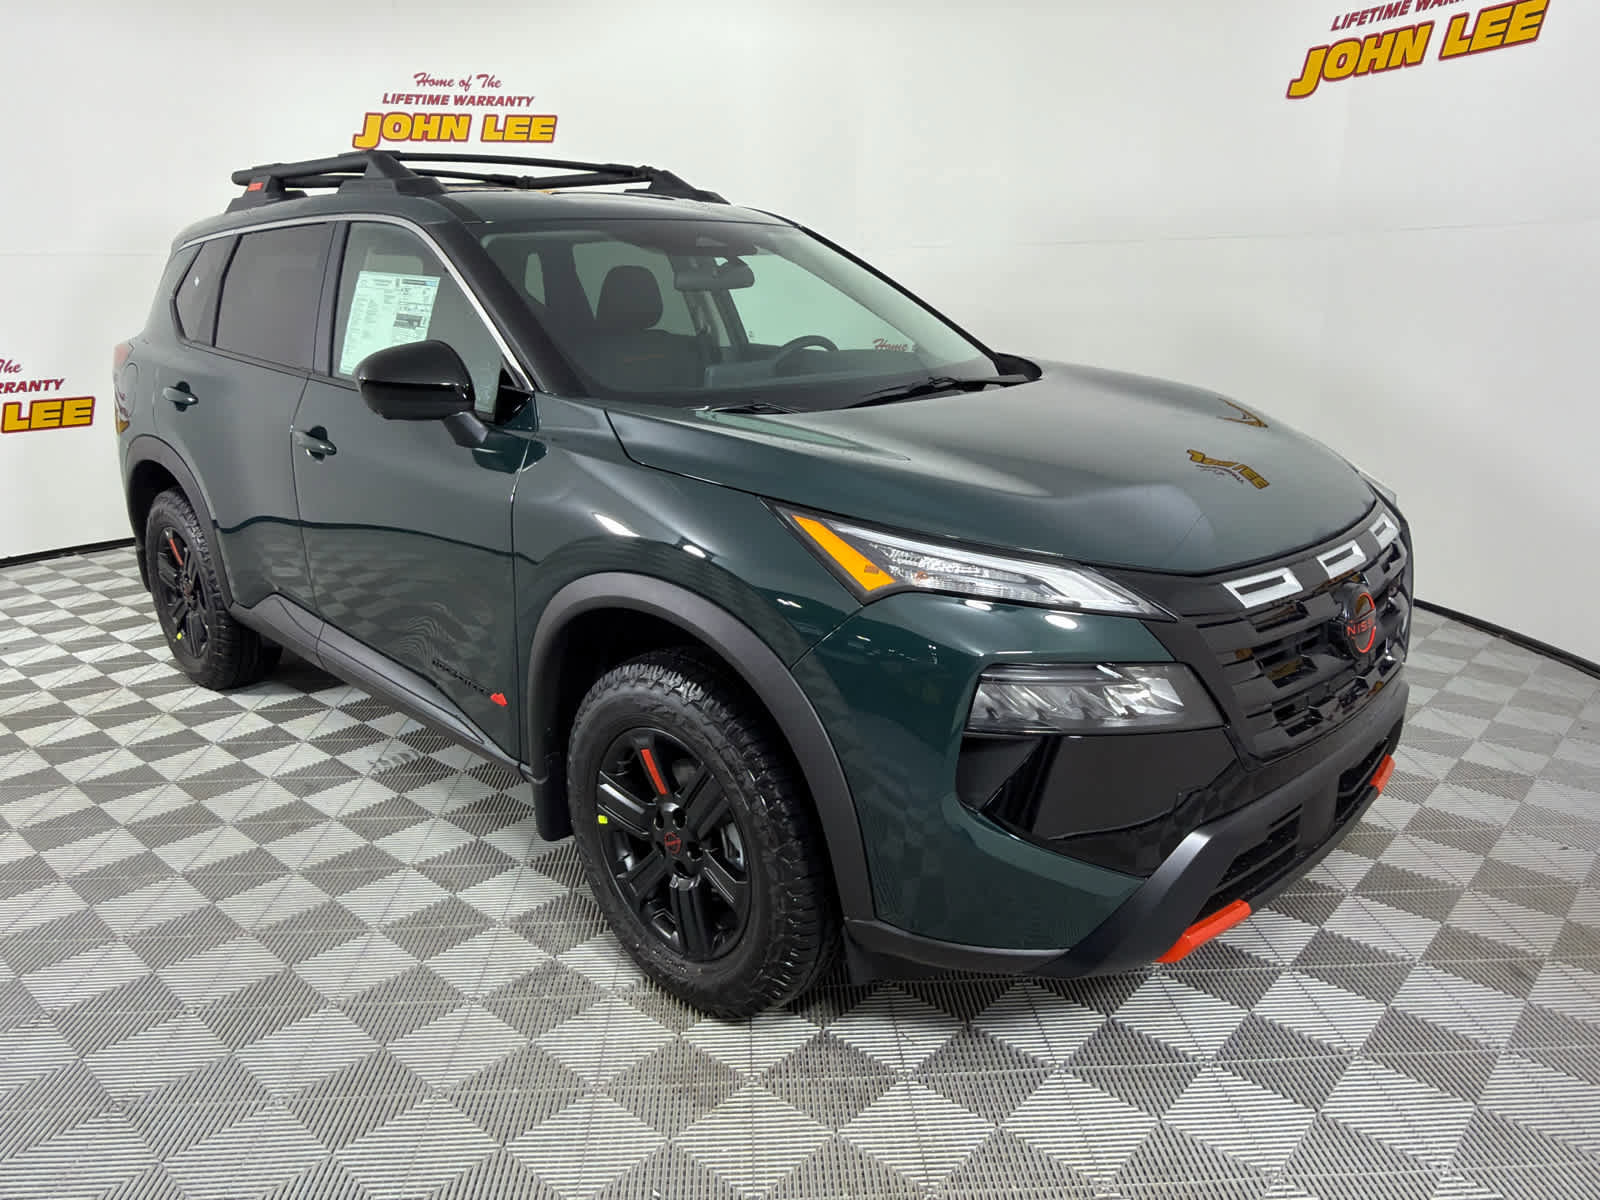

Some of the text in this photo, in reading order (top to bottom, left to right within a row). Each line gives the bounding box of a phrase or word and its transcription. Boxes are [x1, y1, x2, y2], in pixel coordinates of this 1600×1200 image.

[1331, 0, 1412, 31] LIFETIME
[1286, 0, 1550, 99] JOHN LEE
[413, 73, 501, 91] Home of The
[382, 93, 535, 107] LIFETIME WARRANTY
[352, 112, 558, 149] JOHN LEE
[0, 378, 64, 394] RANTY
[1, 396, 96, 434] LEE
